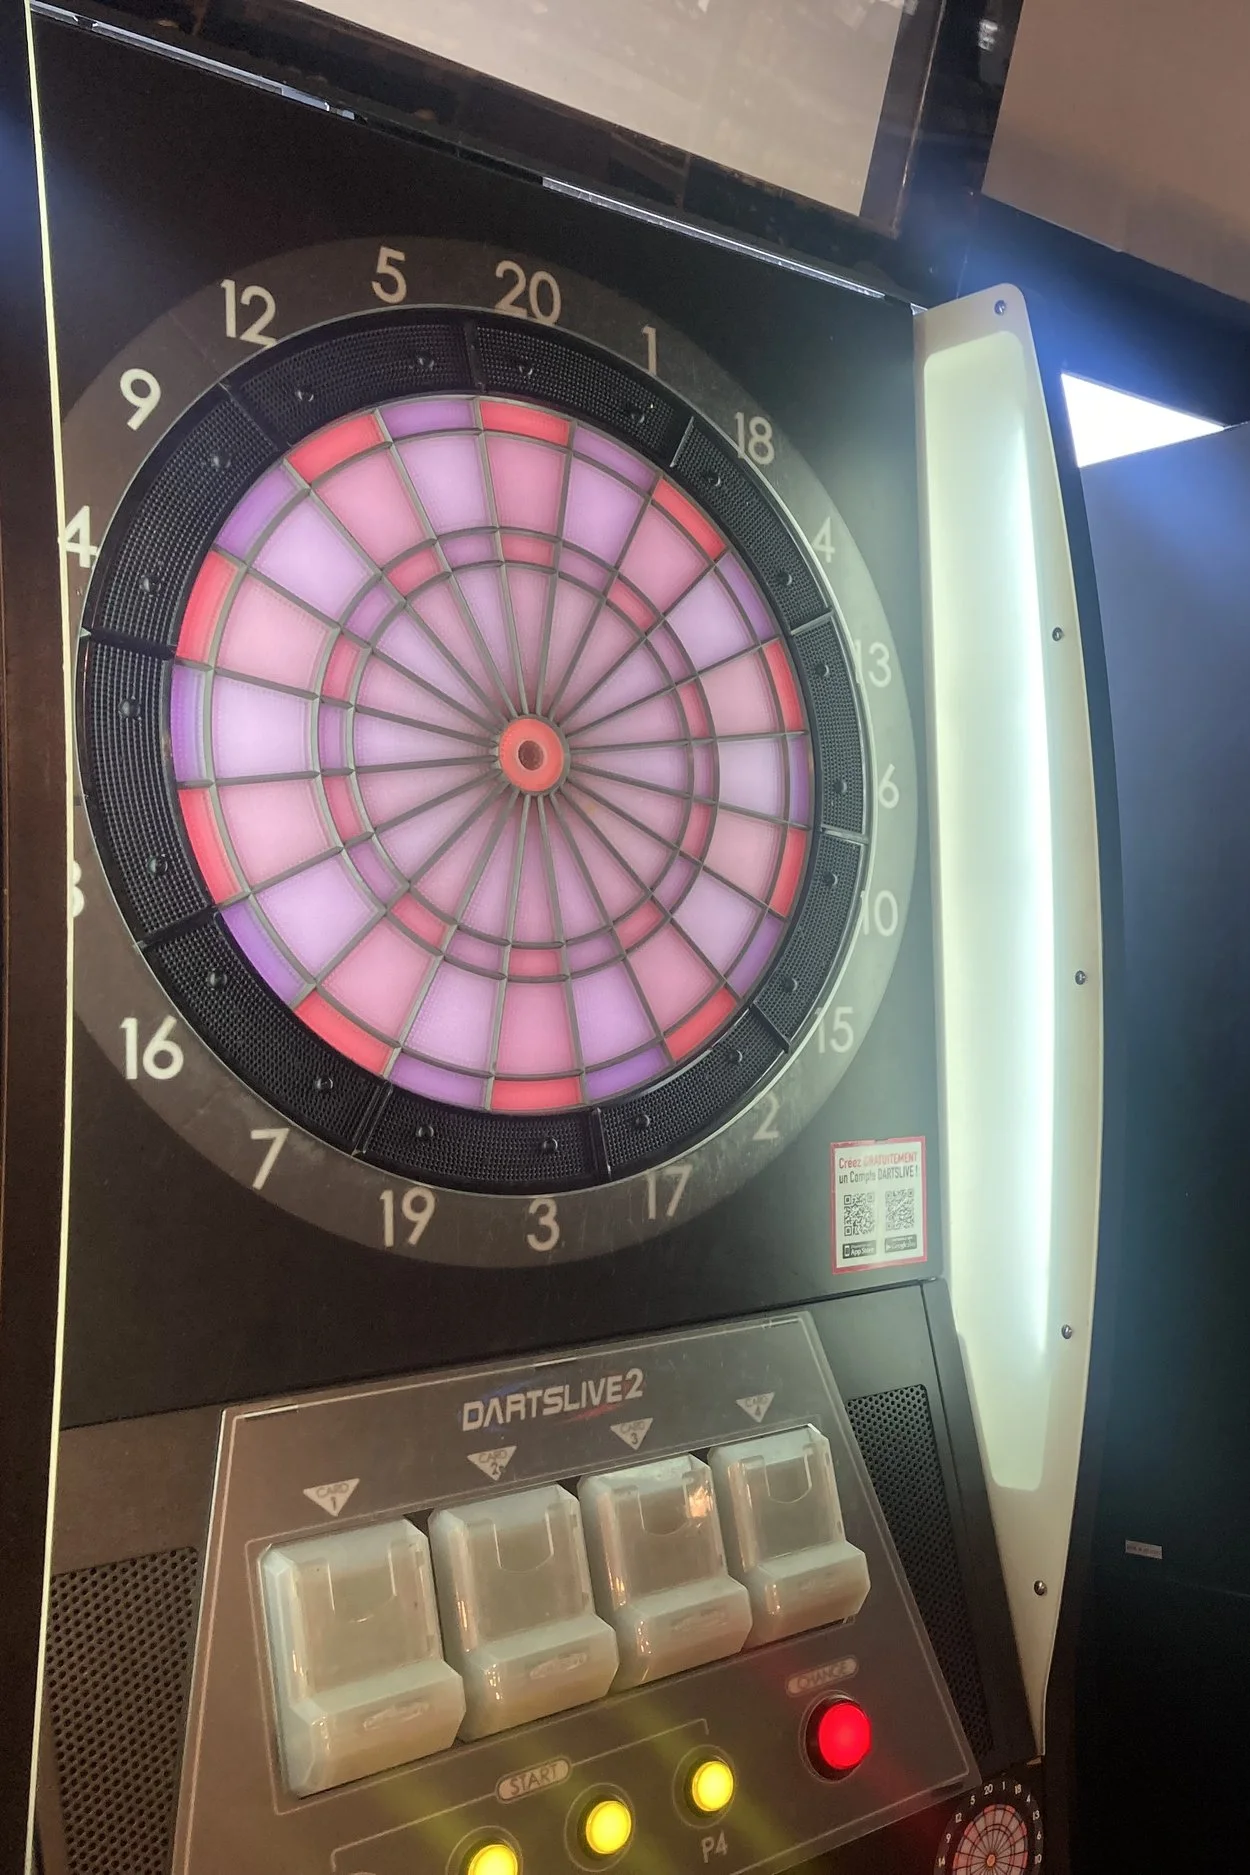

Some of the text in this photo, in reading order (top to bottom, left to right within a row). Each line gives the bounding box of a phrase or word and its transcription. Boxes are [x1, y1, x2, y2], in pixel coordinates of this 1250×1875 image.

[372, 247, 407, 303] 5
[495, 261, 562, 326] 20
[221, 278, 277, 349] 12
[642, 326, 657, 375] 1
[119, 368, 161, 430] 9
[734, 412, 775, 465] 18
[813, 517, 836, 563] 4
[855, 641, 892, 688] 13
[879, 763, 899, 809] 6
[860, 889, 899, 937] 10
[120, 1015, 185, 1081] 16
[814, 1006, 855, 1053] 15
[752, 1096, 780, 1141] 2
[250, 1128, 290, 1190] 7
[839, 1156, 862, 1169] Créez
[839, 1174, 849, 1184] un
[877, 1165, 914, 1180] DARTSLIVE
[646, 1165, 690, 1219] 17
[380, 1186, 436, 1247] 19
[526, 1198, 560, 1252] 3
[462, 1367, 644, 1432] DARTSLIVE2
[631, 1432, 639, 1445] 3
[316, 1482, 350, 1498] CARD
[330, 1496, 337, 1512] 1
[510, 1763, 559, 1796] START
[970, 1795, 976, 1806] 5
[984, 1783, 994, 1796] 20
[701, 1830, 729, 1864] P4
[946, 1833, 952, 1844] 9
